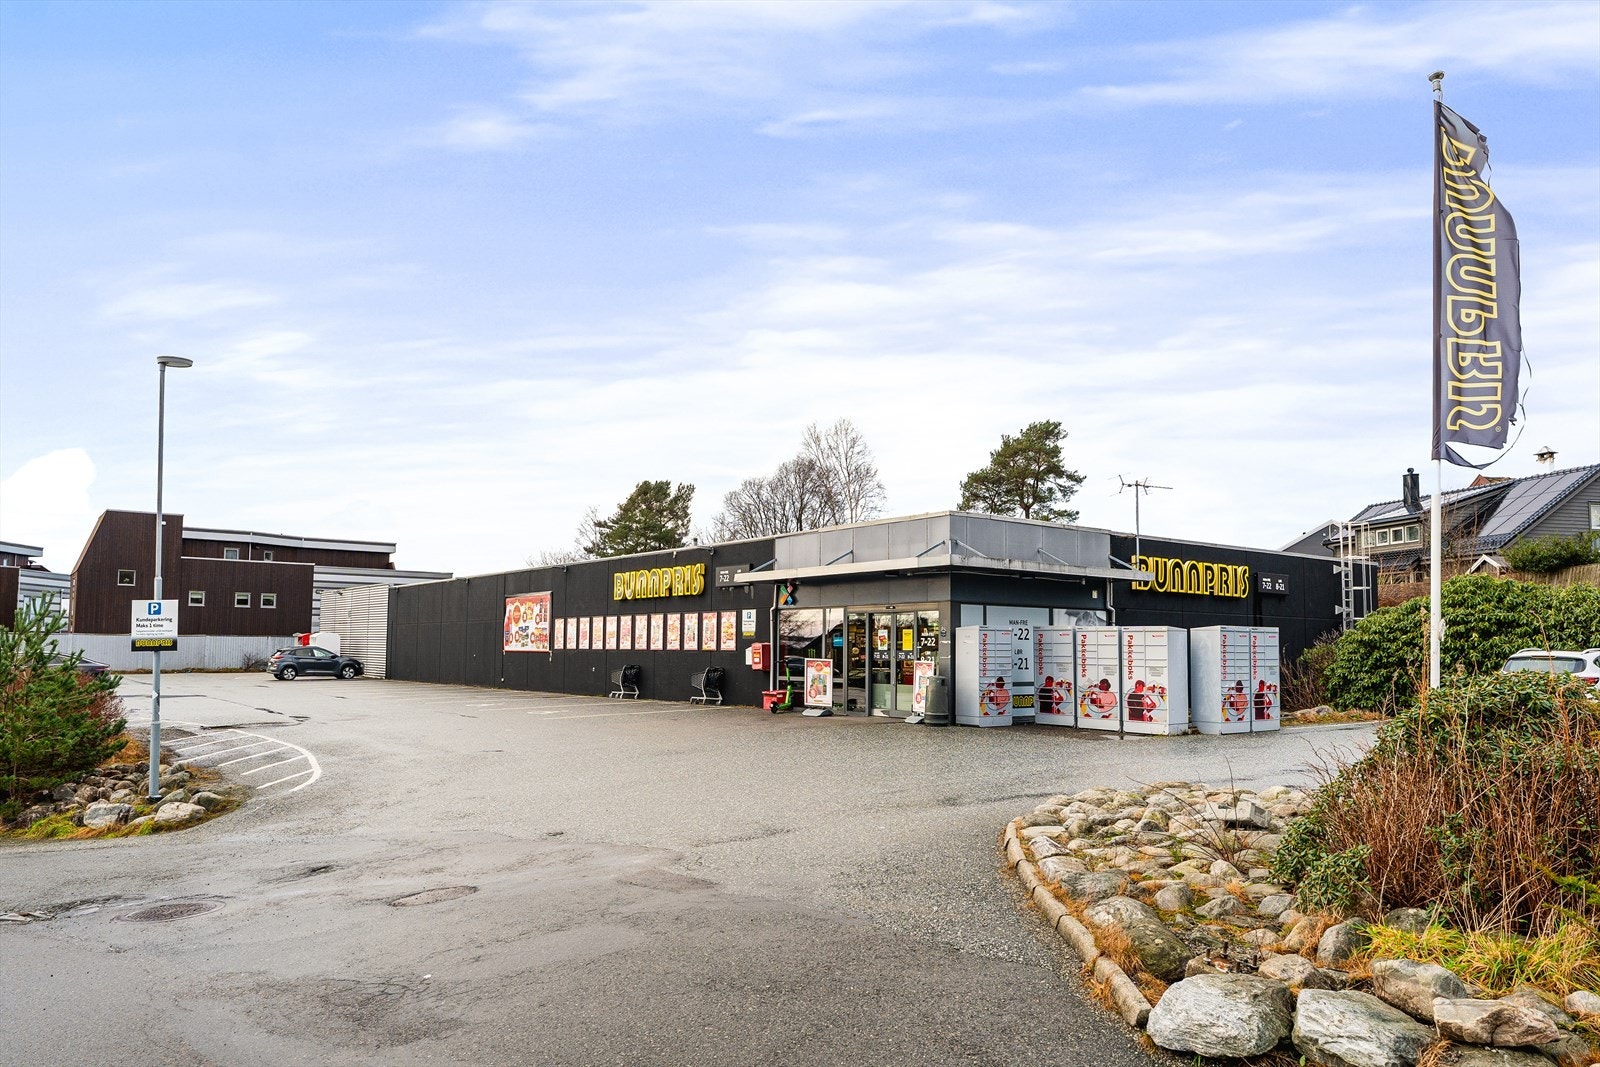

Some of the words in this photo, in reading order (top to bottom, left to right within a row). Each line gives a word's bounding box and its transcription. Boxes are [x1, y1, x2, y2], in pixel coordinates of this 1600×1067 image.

[613, 563, 705, 600] BUNNPRIS
[1131, 555, 1248, 598] BUNNPRIS
[1262, 582, 1272, 590] 7-22
[151, 603, 159, 614] P
[1012, 628, 1030, 641] -22
[920, 637, 936, 646] 7-22
[1012, 657, 1029, 670] -21
[1012, 695, 1034, 707] UNNP
